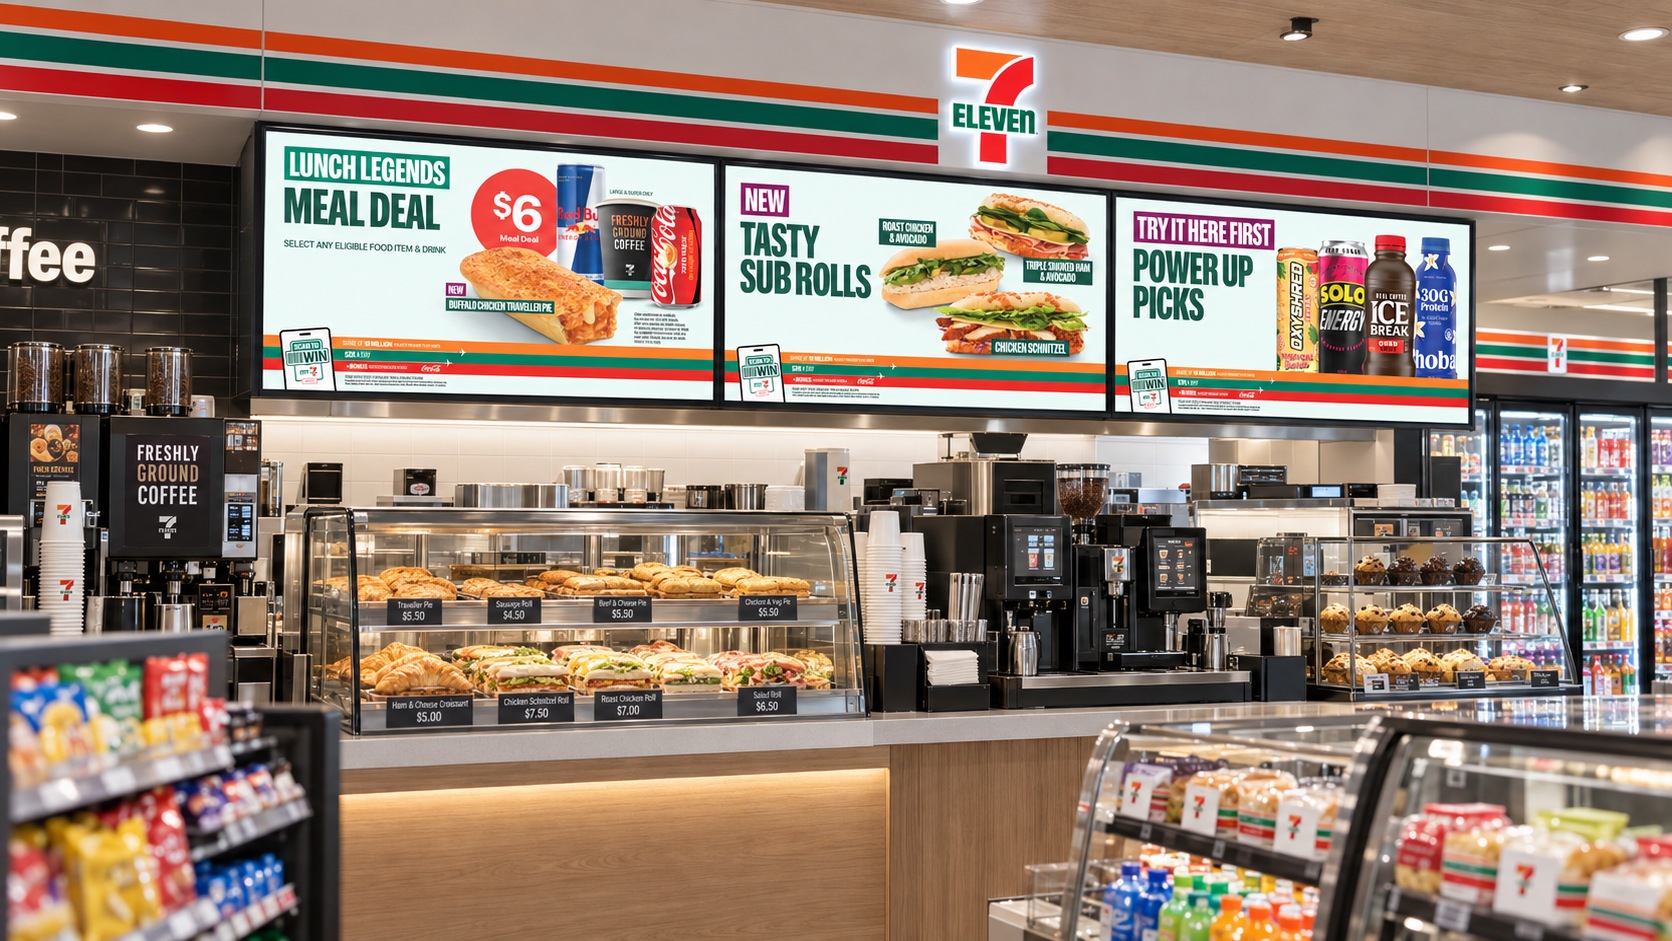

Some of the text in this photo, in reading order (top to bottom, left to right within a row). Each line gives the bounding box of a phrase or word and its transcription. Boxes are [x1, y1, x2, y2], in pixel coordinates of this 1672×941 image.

[957, 48, 1034, 164] 7
[290, 151, 446, 186] LUNCH LEGENDS
[284, 187, 441, 230] MEAL DEAL
[745, 187, 786, 213] NEW
[492, 191, 542, 232] $6
[584, 208, 599, 222] Bu
[611, 214, 649, 227] FRESHLY
[882, 221, 904, 232] ROAST
[1137, 216, 1272, 247] TRY IT HERE FIRST
[284, 239, 446, 254] SELECT ANY ELIGIBLE FOOD ITEM & DRINK
[500, 234, 539, 244] Meal Deal
[614, 239, 645, 251] COFFEE
[740, 221, 820, 259] TASTY
[889, 234, 894, 243] &
[1133, 248, 1254, 288] POWER UP
[740, 258, 872, 299] SUB ROLLS
[448, 285, 464, 294] NEW
[1320, 284, 1365, 303] SOLO
[1420, 289, 1448, 302] 30G
[1133, 285, 1205, 322] PICKS
[1320, 309, 1365, 332] ENERGY
[1370, 300, 1410, 326] ICE
[1370, 324, 1409, 337] BREAK
[304, 350, 327, 363] WIN
[995, 342, 1026, 354] CHICKEN
[756, 365, 777, 376] WIN
[1144, 379, 1164, 390] WIN
[137, 444, 199, 462] FRESHLY
[137, 464, 199, 483] GROUND
[837, 466, 848, 485] 7
[138, 485, 198, 504] COFFEE
[57, 505, 72, 525] 7
[60, 580, 74, 600] 7
[886, 574, 897, 592] 7
[915, 582, 924, 600] 7
[503, 610, 525, 620] $4.50
[409, 700, 413, 709] &
[503, 696, 528, 706] Chicken
[601, 694, 618, 703] Roast
[756, 702, 778, 712] $6.50
[417, 711, 442, 722] $5.00
[525, 708, 549, 719] $7.50
[617, 705, 640, 716] $7.00
[1132, 782, 1141, 803] 7
[1194, 796, 1205, 818] 7
[1289, 815, 1302, 839] 7
